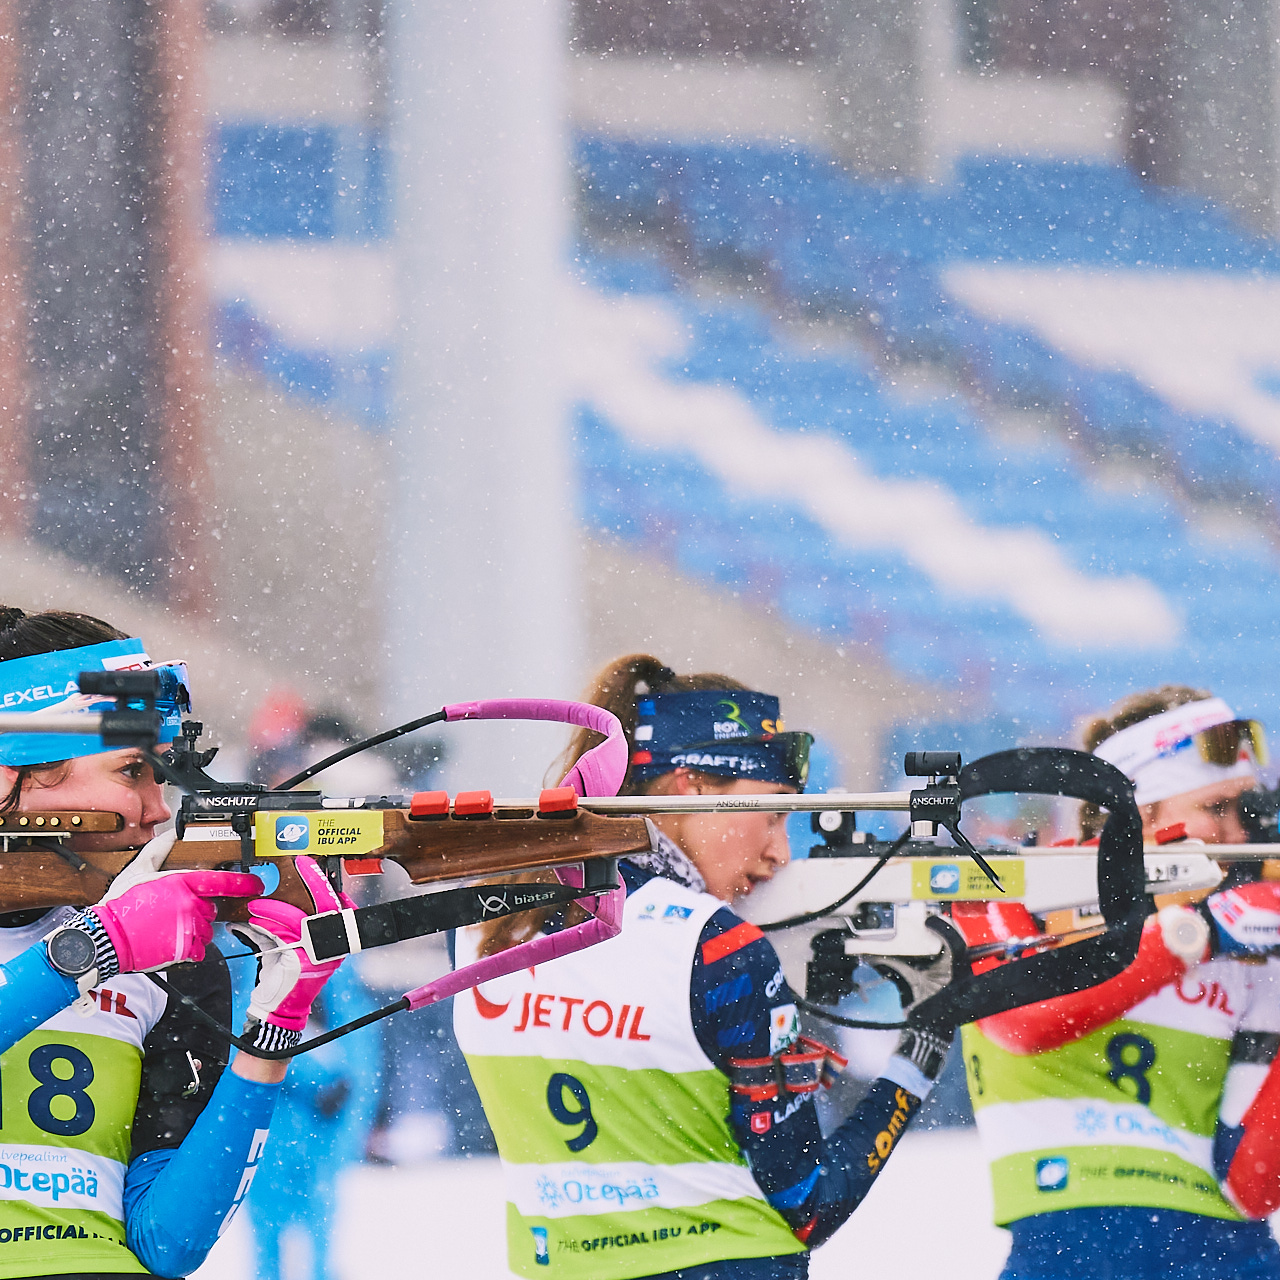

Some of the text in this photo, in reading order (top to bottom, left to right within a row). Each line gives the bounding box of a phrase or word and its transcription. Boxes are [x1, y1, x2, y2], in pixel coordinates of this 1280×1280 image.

[671, 753, 740, 768] CRAFT
[318, 819, 335, 827] THE
[318, 827, 361, 836] OFFICIAL
[318, 836, 357, 845] IBU APP
[514, 889, 556, 905] biatar
[513, 993, 651, 1043] JETOIL
[1107, 1032, 1157, 1107] 8
[546, 1072, 599, 1153] 9
[581, 1232, 649, 1251] OFFICIAL
[653, 1227, 681, 1242] IBU
[687, 1222, 721, 1235] APP
